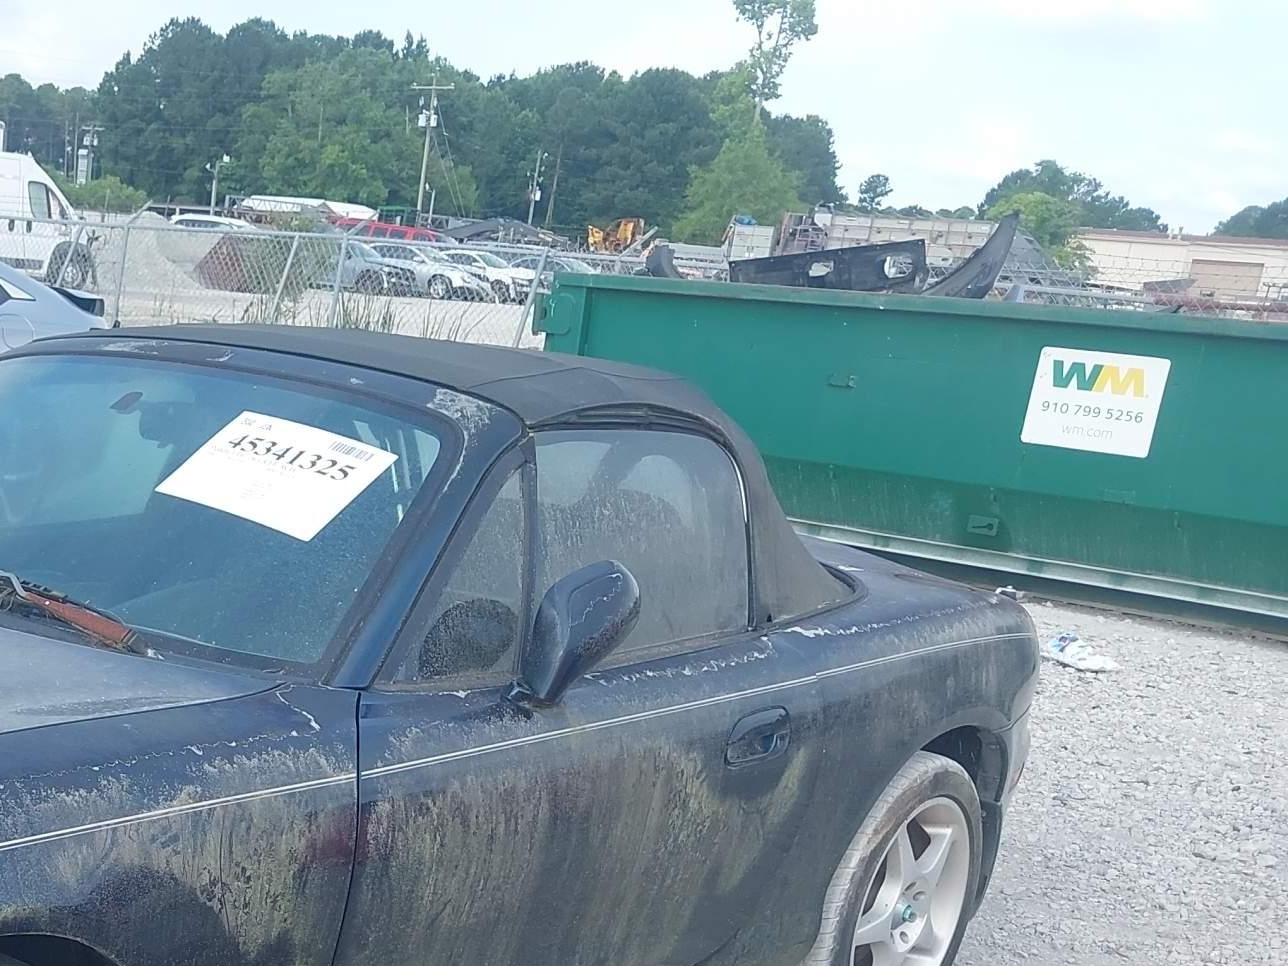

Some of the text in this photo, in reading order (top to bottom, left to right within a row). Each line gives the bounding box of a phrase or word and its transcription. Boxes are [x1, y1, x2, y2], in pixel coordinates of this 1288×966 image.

[1052, 359, 1145, 398] WM
[1041, 400, 1144, 423] 910 799 5256
[1062, 424, 1113, 440] wm.com
[228, 434, 356, 481] 45341325
